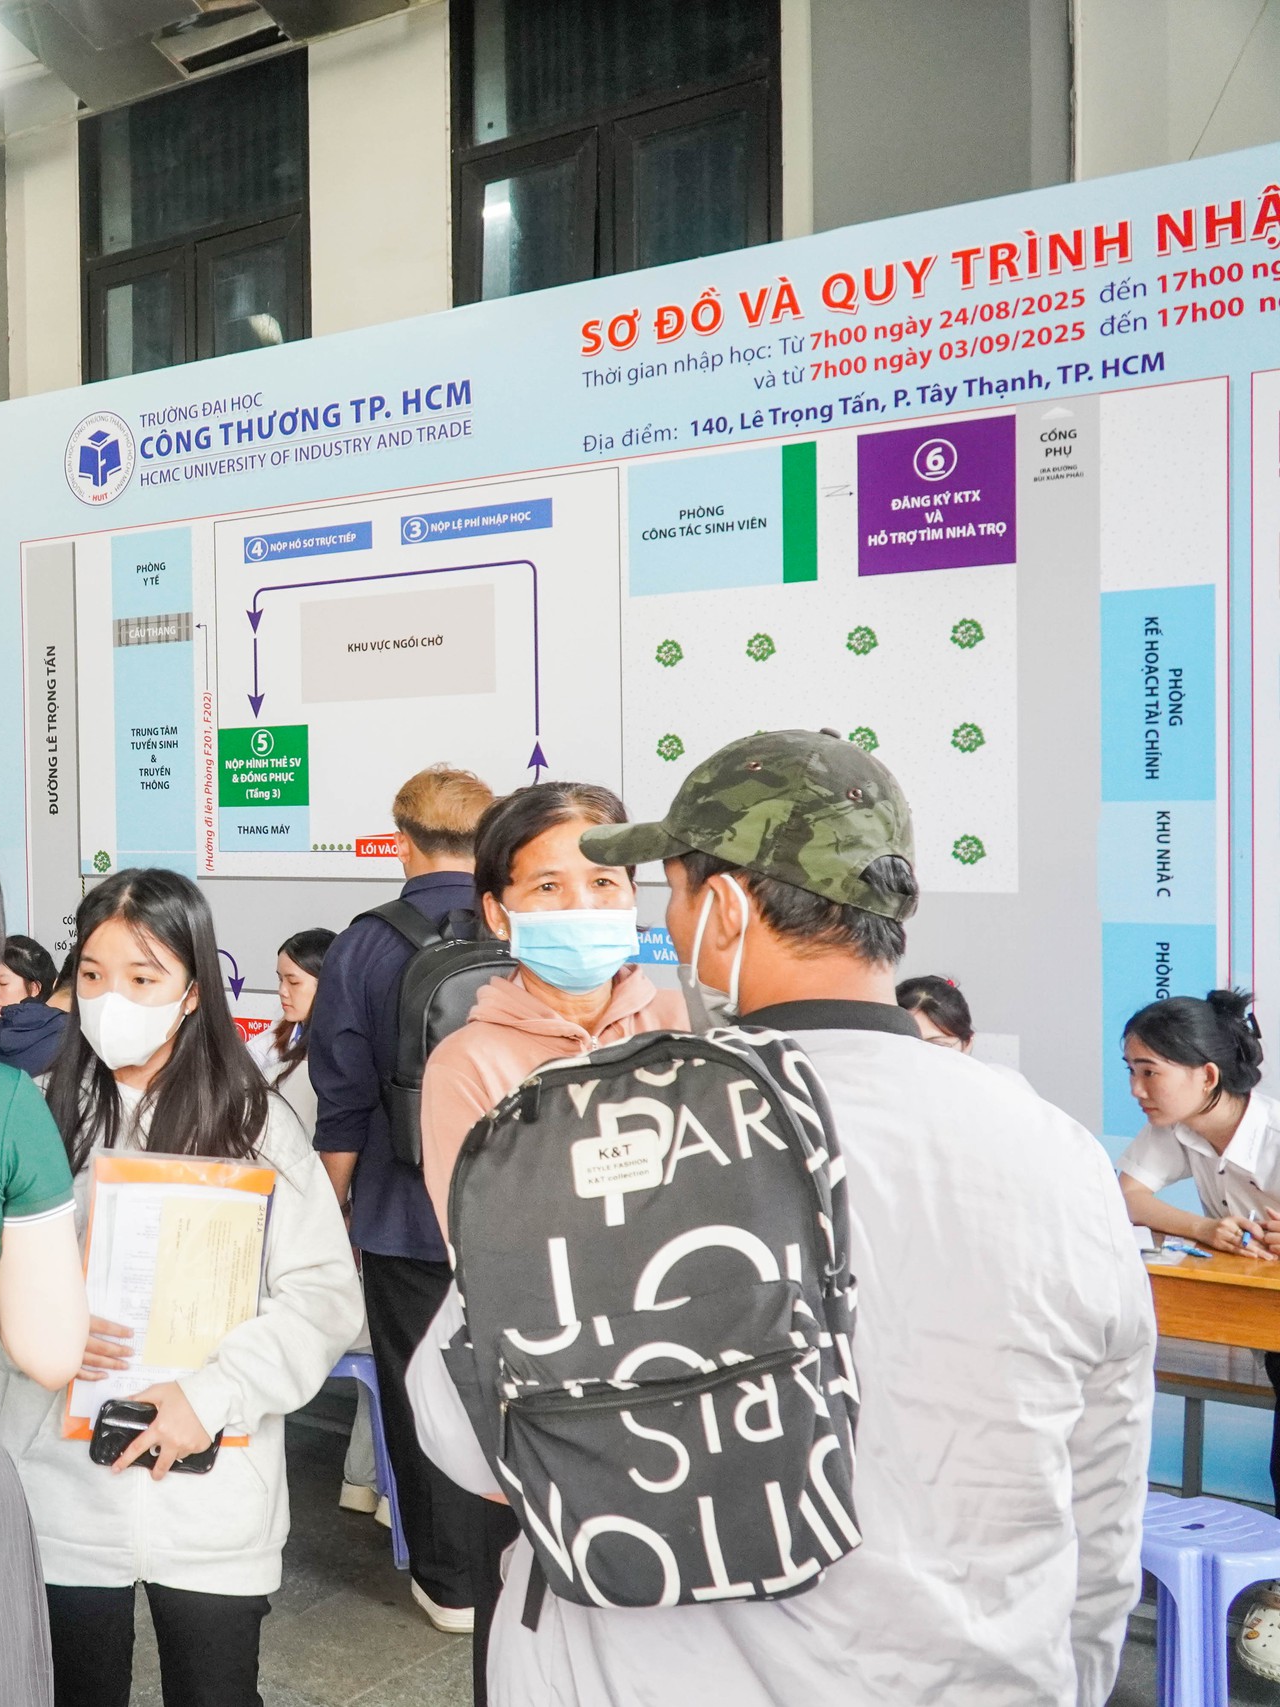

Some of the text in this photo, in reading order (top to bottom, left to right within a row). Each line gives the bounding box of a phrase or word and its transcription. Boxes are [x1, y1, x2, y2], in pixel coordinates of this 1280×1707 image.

[581, 309, 642, 356] SƠ
[653, 287, 725, 344] ĐỒ
[738, 276, 805, 328] VÀ
[821, 256, 938, 315] QUY
[951, 220, 1132, 290] TRÌNH
[583, 263, 1243, 387] Thời gian nhập học: Từ 7h00 ngày 24/08/2025 đến 17h00
[754, 297, 1244, 389] và từ 7h00 ngày 03/09/2025 đến 17h00
[140, 392, 263, 428] TRƯỜNG ĐẠI HỌC
[583, 352, 1165, 454] Địa điểm: 140, Lê Trọng Tấn, P. Tây Thạnh, TP. HCM
[140, 381, 471, 460] CÔNG THƯƠNG TP. HCM
[140, 420, 472, 486] HCMC UNIVERSITY OF INDUSTRY AND TRADE
[1045, 446, 1072, 458] PHỤ
[92, 493, 108, 501] HUIT
[891, 489, 980, 511] ĐĂNG KÝ KTX
[679, 504, 724, 520] PHÒNG
[925, 508, 943, 523] VÀ
[431, 511, 531, 533] NỘP LỆ PHÍ NHẬP HỌC
[642, 517, 767, 541] CÔNG TÁC SINH VIÊN
[270, 531, 356, 552] NỘP SƠ TRỰC TIẾP
[889, 521, 1007, 545] TRỢ TÌM NHÀ TRỌ
[136, 562, 166, 573] PHÒNG
[143, 574, 160, 586] Y TẾ
[147, 626, 176, 637] THANG
[347, 642, 368, 652] KHU
[370, 639, 391, 652] VỰC
[421, 634, 444, 648] CHỜ
[1141, 617, 1164, 779] KẾ HOẠCH TÀI CHÍNH
[1169, 668, 1186, 727] PHÒNG
[43, 645, 59, 815] ĐƯỜNG LÊ TRỌNG TẤN
[131, 725, 177, 737] TRUNG TÂM
[159, 739, 178, 750] SINH
[151, 754, 157, 763] &
[225, 755, 301, 771] NỘP HÌNH THẺ SV
[141, 778, 170, 790] THÔNG
[203, 691, 215, 872] (Hướng đi lên Phòng F201, F202)
[232, 772, 294, 784] & PHỤC
[272, 789, 280, 799] 3)
[237, 824, 290, 834] THANG MÁY
[361, 842, 377, 854] LỐI
[1156, 811, 1174, 897] KHU NHÀ C
[1156, 942, 1173, 1000] PHÒNG
[599, 1144, 631, 1159] K&T
[587, 1158, 648, 1173] STYLE FASHION
